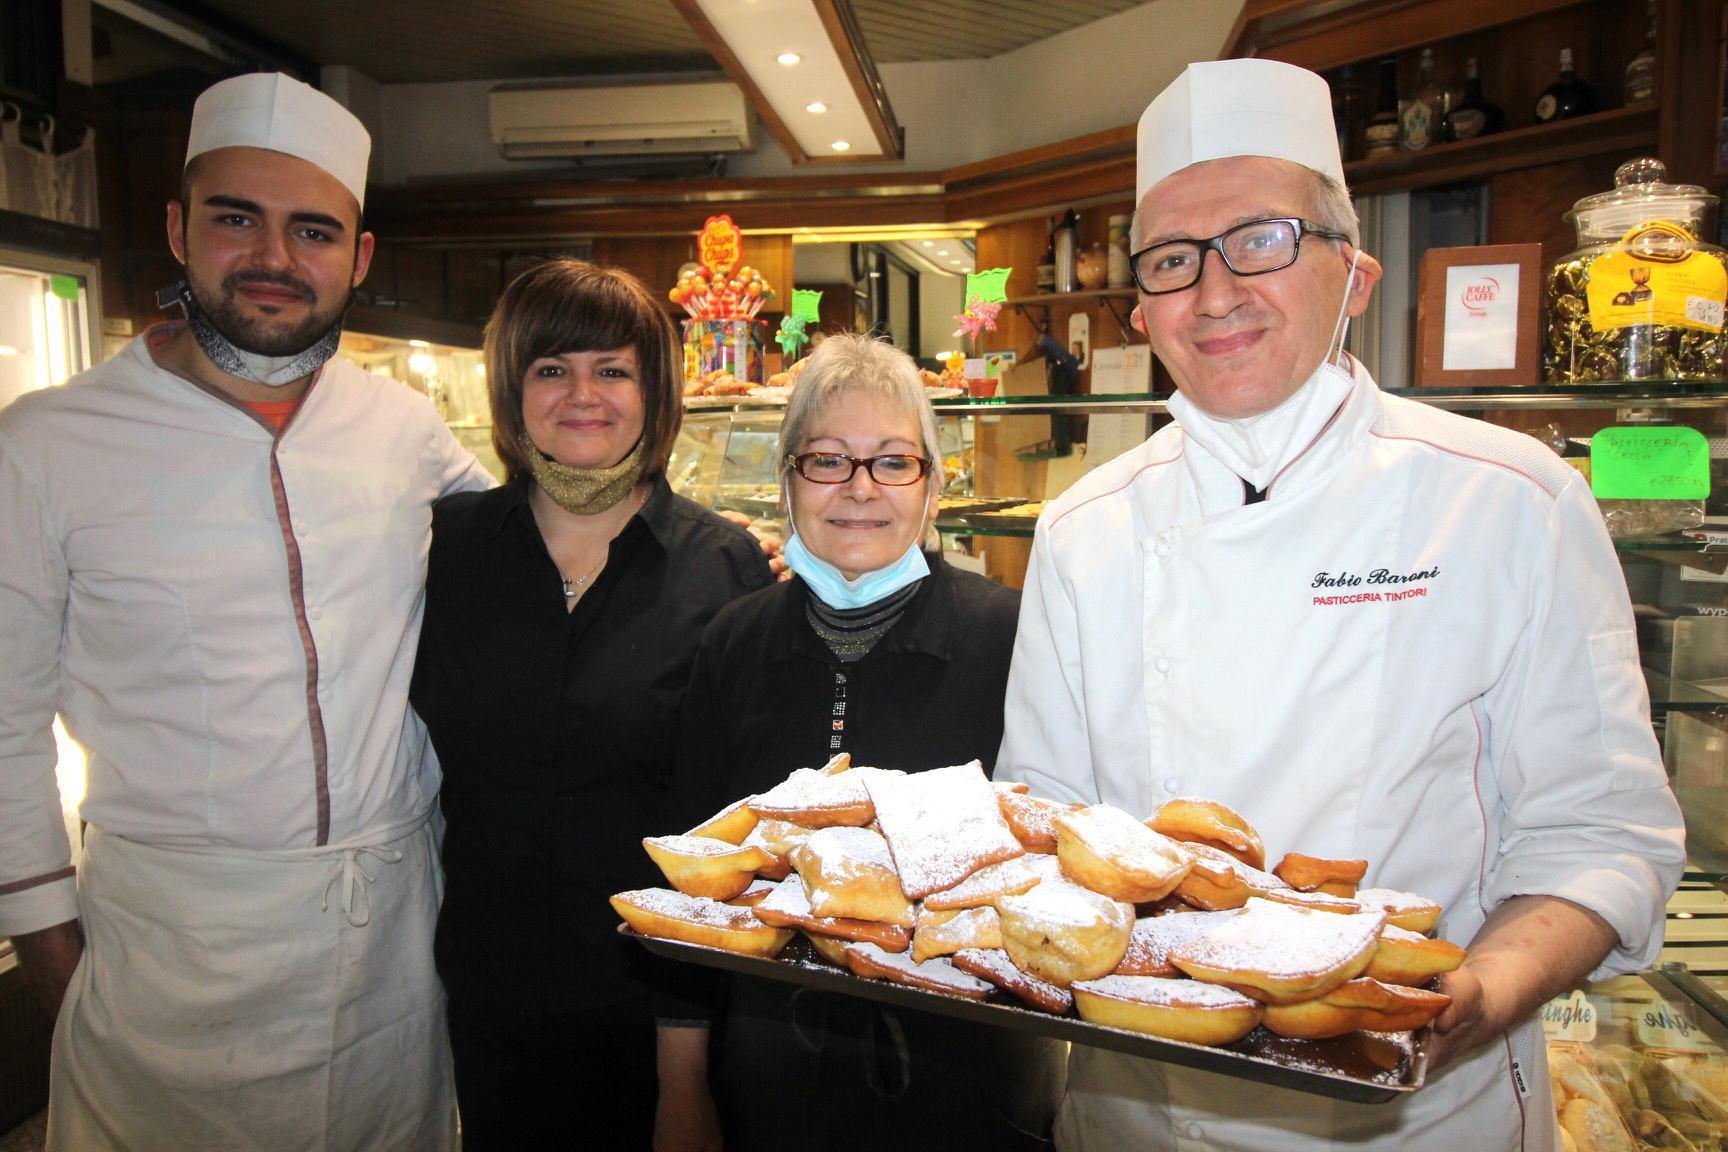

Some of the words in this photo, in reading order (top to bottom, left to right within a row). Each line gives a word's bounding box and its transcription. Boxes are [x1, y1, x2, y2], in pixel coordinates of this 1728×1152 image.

[1467, 284, 1495, 294] JOLLY
[1709, 536, 1728, 545] Prat
[1311, 572, 1363, 588] Fabio
[1367, 566, 1440, 585] Baroni
[1313, 592, 1382, 606] PASTICCERIA
[1384, 587, 1427, 602] TINTORI
[1697, 606, 1728, 617] wyp
